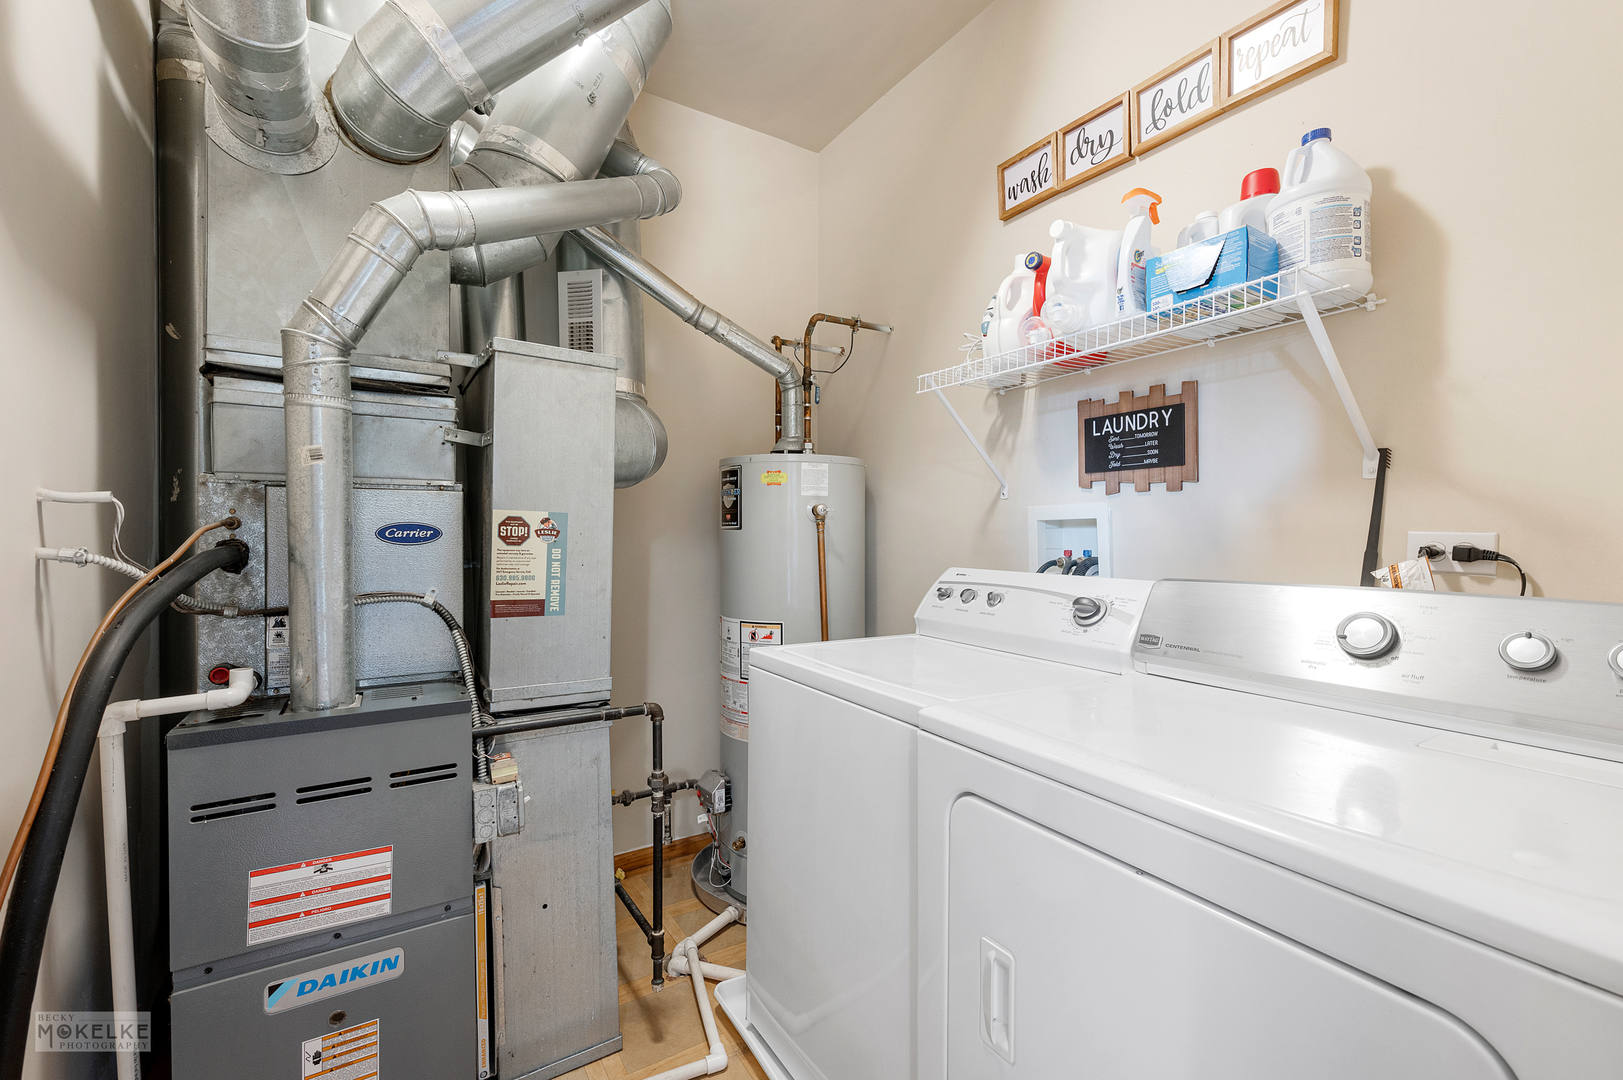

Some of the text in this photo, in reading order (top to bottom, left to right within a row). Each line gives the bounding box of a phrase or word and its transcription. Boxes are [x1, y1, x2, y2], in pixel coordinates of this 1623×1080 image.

[593, 11, 611, 24] OPEN
[1236, 3, 1320, 80] repeat
[1145, 62, 1210, 135] fold
[1070, 127, 1123, 166] dry
[1007, 152, 1052, 201] wash
[1093, 409, 1172, 436] LAUNDRY
[1134, 431, 1159, 439] TOMORROW
[385, 528, 434, 539] Carrier
[500, 526, 528, 537] STOP!
[549, 548, 561, 612] DO NOT REMOVE
[1165, 643, 1200, 652] CENTENNIAL
[1507, 674, 1547, 683] temperature
[296, 955, 400, 997] DAIKIN
